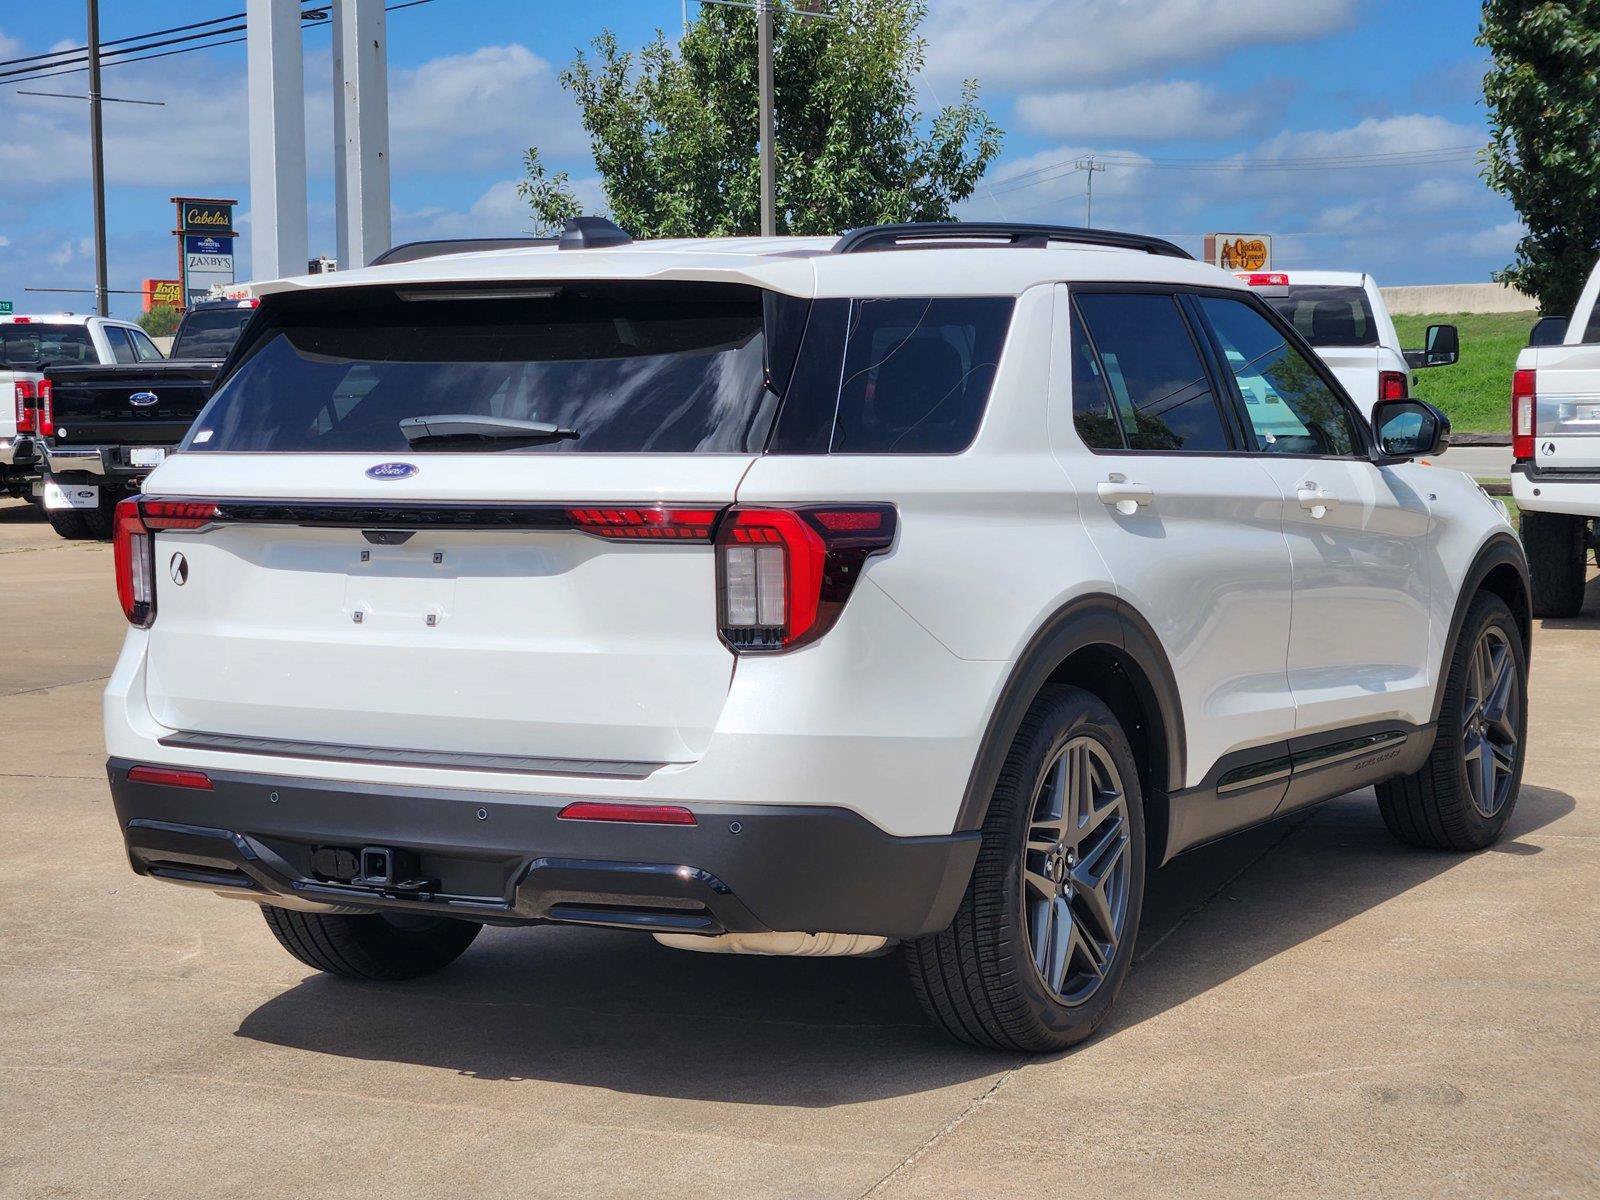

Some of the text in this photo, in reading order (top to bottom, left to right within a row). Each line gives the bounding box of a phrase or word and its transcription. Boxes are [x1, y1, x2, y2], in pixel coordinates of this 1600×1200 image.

[187, 208, 230, 225] Cabela's
[190, 256, 231, 269] ZAXBY'S
[373, 464, 408, 476] Ford
